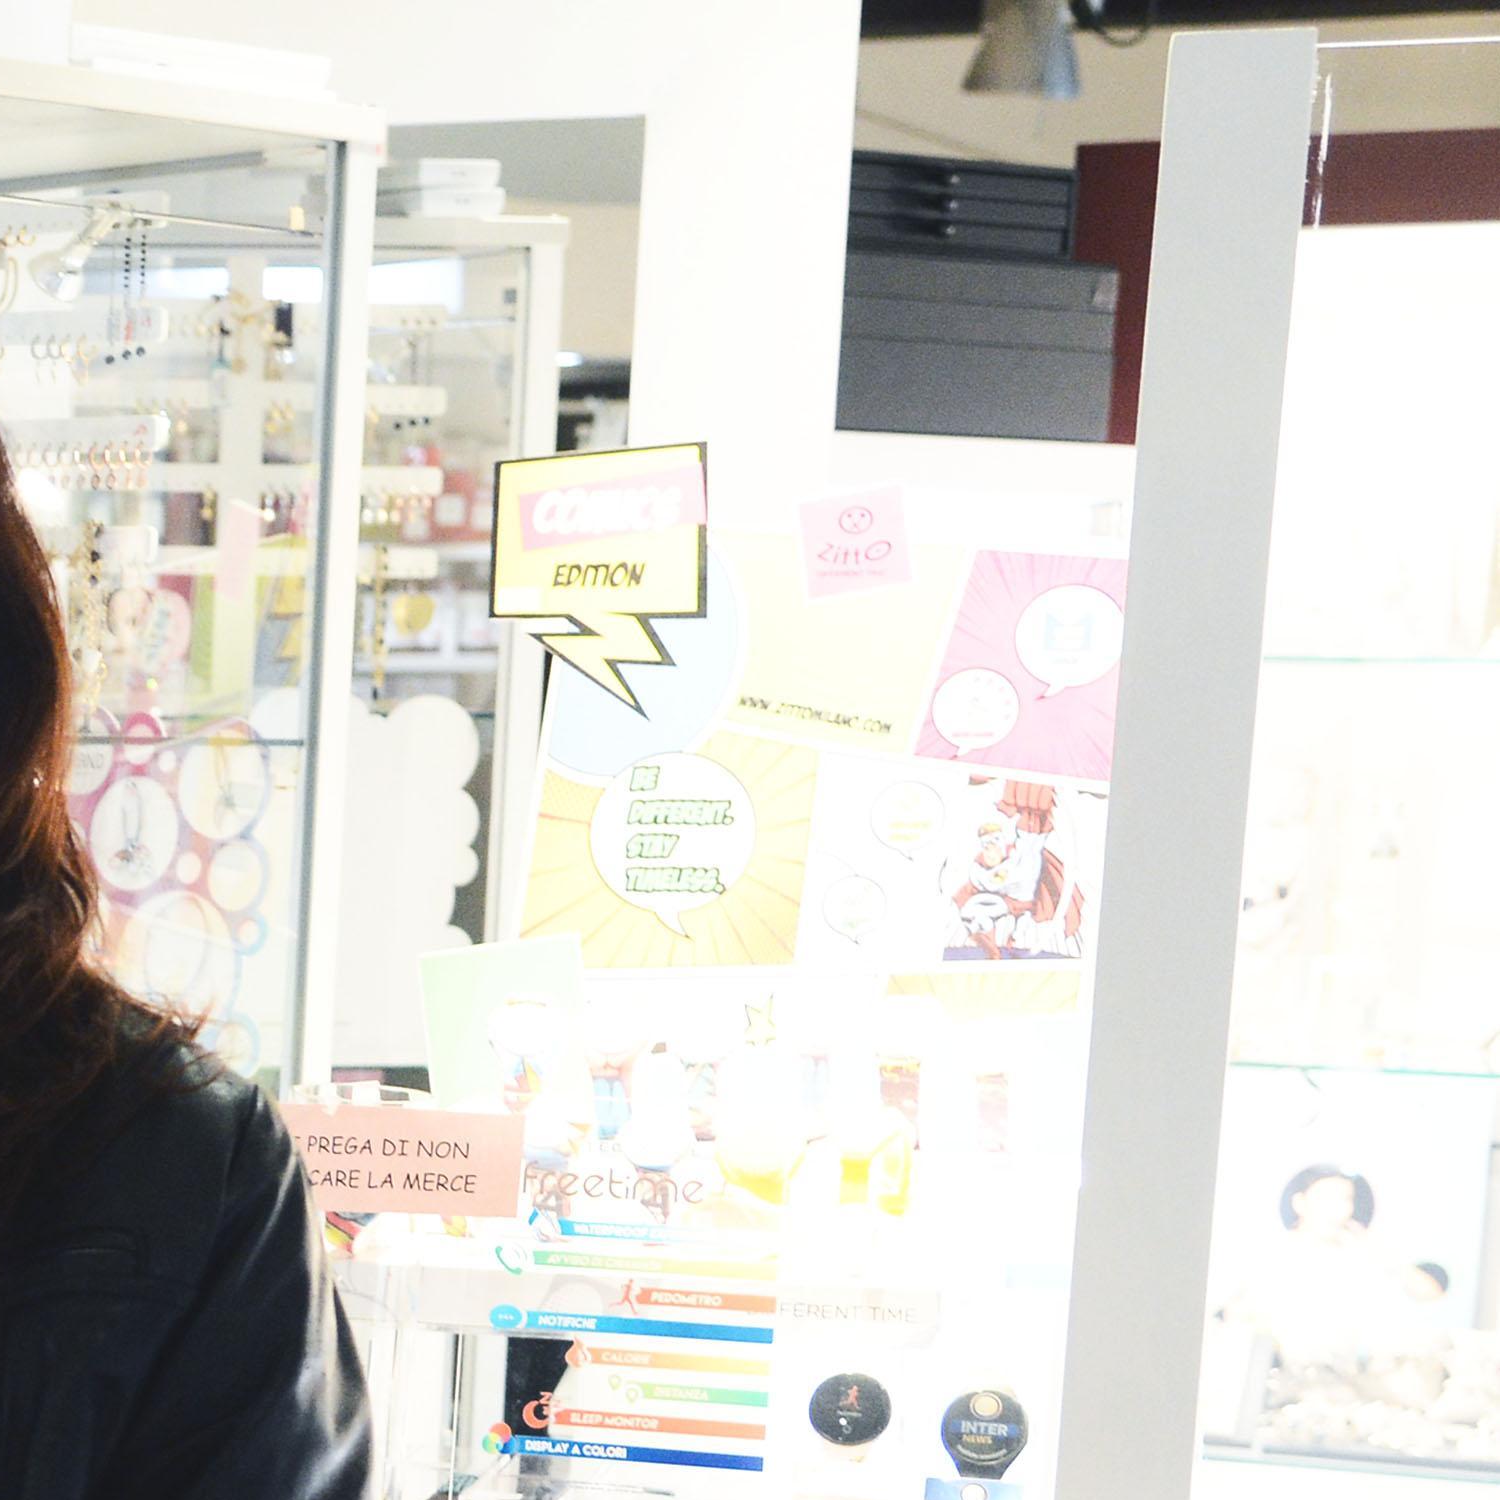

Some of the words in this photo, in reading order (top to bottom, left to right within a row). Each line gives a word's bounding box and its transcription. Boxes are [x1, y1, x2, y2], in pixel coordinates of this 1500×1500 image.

[552, 561, 646, 589] EDITION
[306, 1134, 373, 1158] PREGA
[381, 1137, 410, 1158] DI
[416, 1140, 471, 1161] NON
[309, 1167, 361, 1189] CARE
[367, 1170, 395, 1191] LA
[403, 1171, 478, 1195] MERCE
[650, 1291, 723, 1307] PEDOMETRO
[538, 1314, 598, 1330] NOTIFICHE
[780, 1303, 862, 1321] FERENT
[870, 1306, 919, 1324] TIME
[570, 1412, 603, 1426] SLEEP
[604, 1415, 660, 1430] MONITOR
[961, 1420, 1009, 1437] INTER
[524, 1439, 569, 1455] DISPLAY
[571, 1444, 581, 1456] A
[582, 1444, 628, 1459] COLORI
